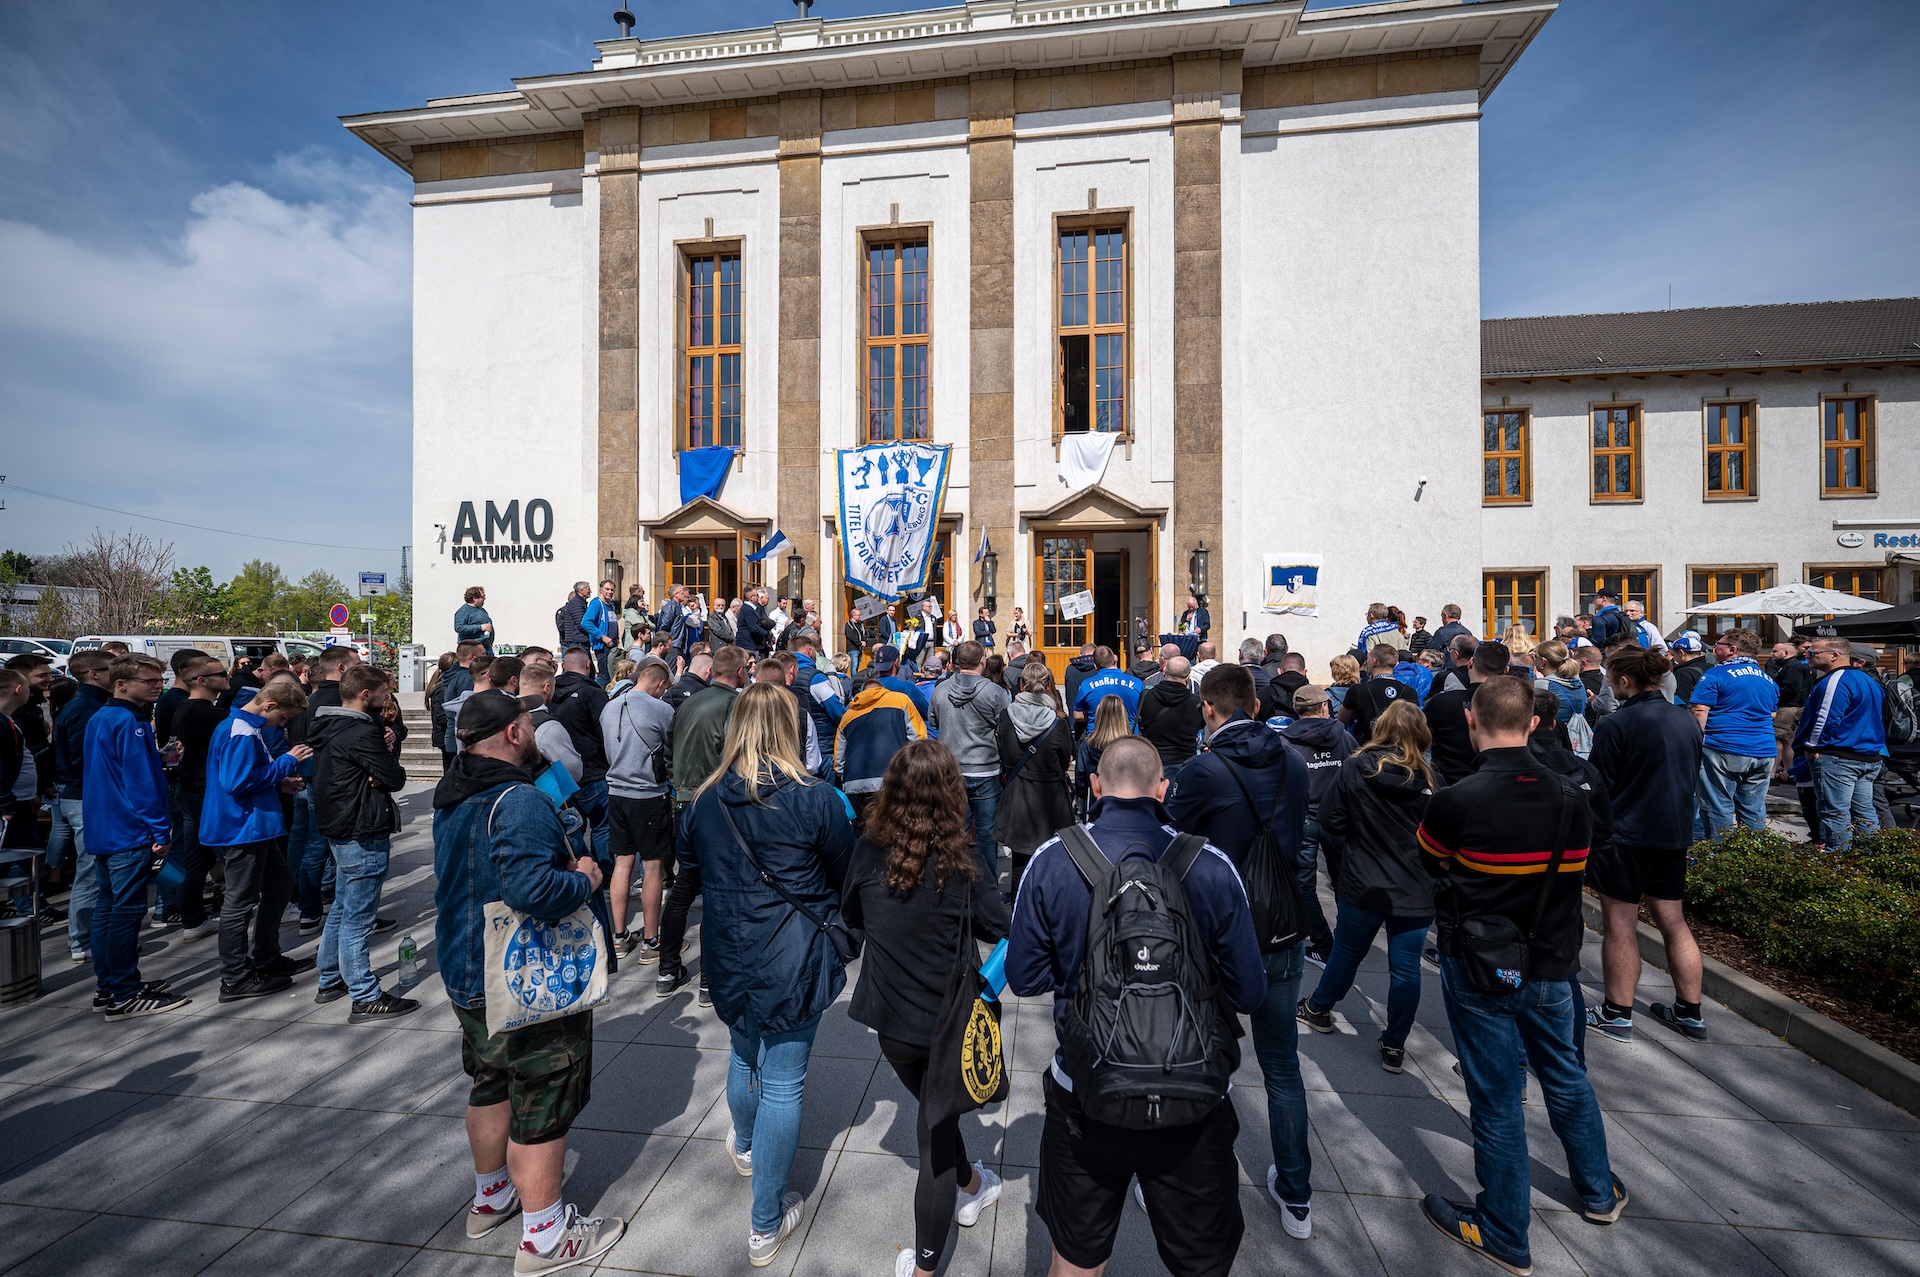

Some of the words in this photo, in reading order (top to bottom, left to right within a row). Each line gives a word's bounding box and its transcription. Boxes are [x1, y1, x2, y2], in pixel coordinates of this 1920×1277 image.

[452, 498, 554, 544] AMO
[848, 504, 861, 534] TITEL
[1874, 532, 1920, 548] Rest
[451, 543, 554, 564] KULTURHAUS
[1089, 676, 1118, 690] FanRat
[1120, 679, 1134, 690] e.V.
[1320, 751, 1331, 760] FC
[1133, 962, 1161, 971] deuter
